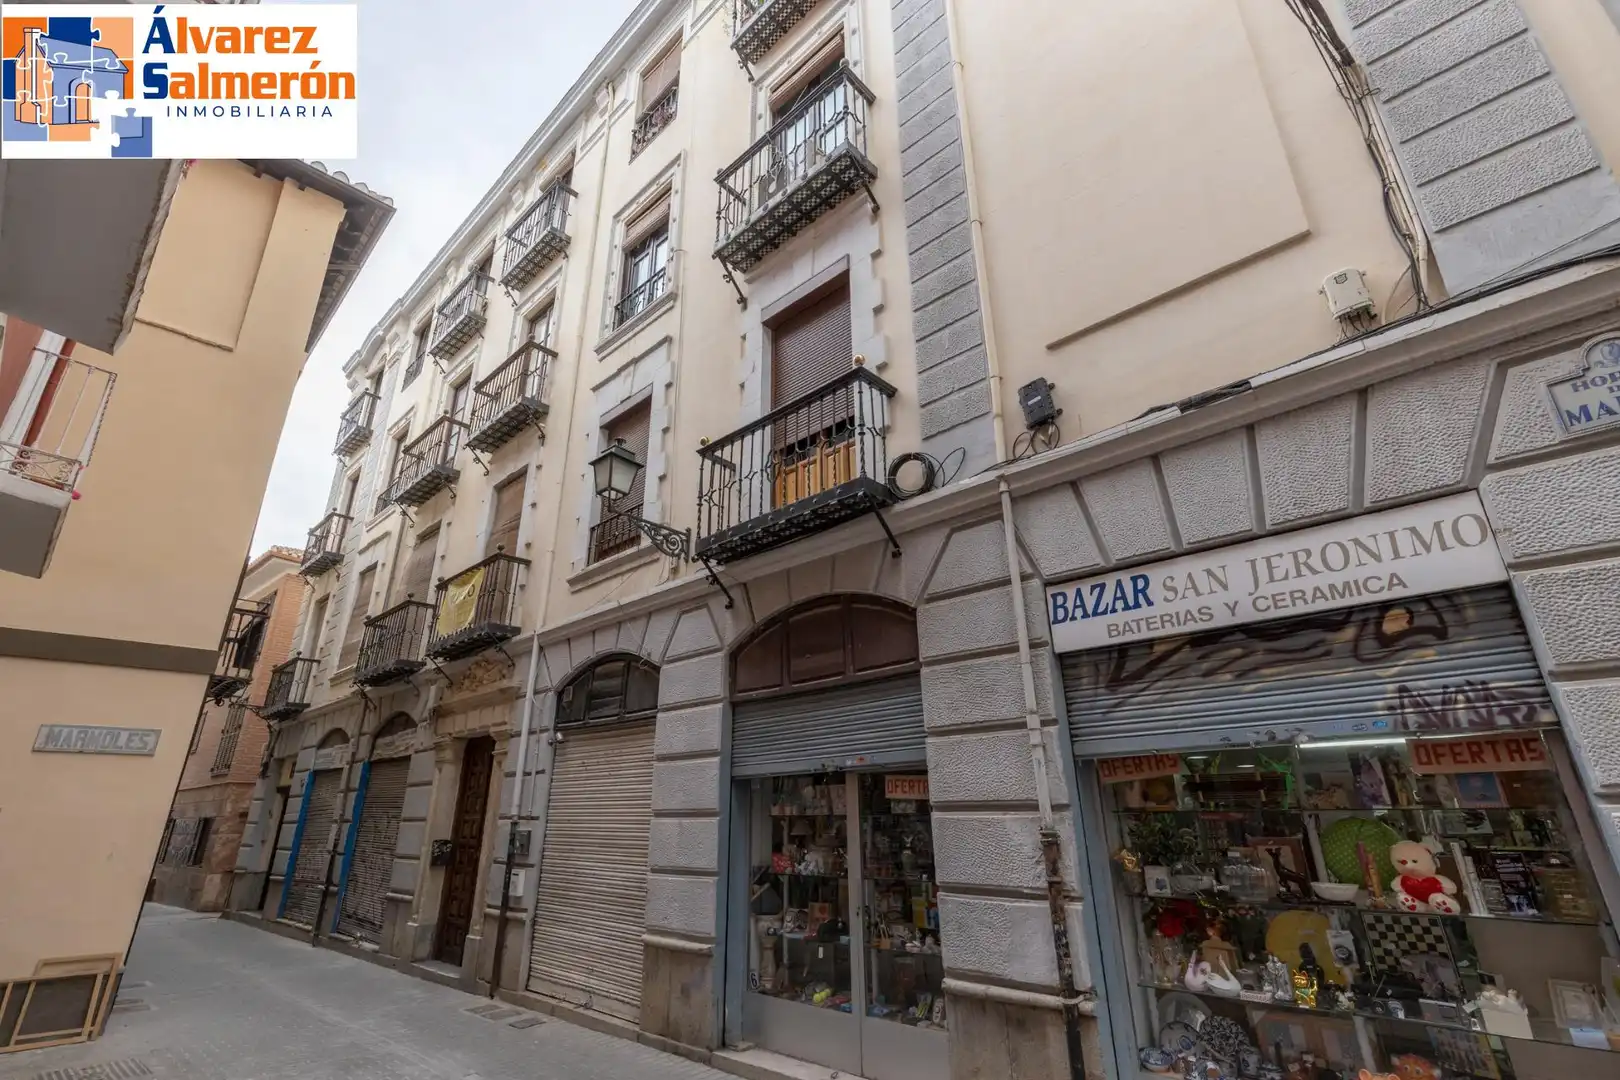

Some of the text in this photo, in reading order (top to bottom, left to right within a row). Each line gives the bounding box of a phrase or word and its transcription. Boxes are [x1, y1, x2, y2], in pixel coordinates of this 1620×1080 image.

[1050, 513, 1489, 626] BAZAR SAN JERONIMO
[1106, 572, 1409, 639] BATERIAS Y CERAMICA
[45, 727, 152, 750] MARMOLES
[1414, 738, 1546, 766] OFERTAS
